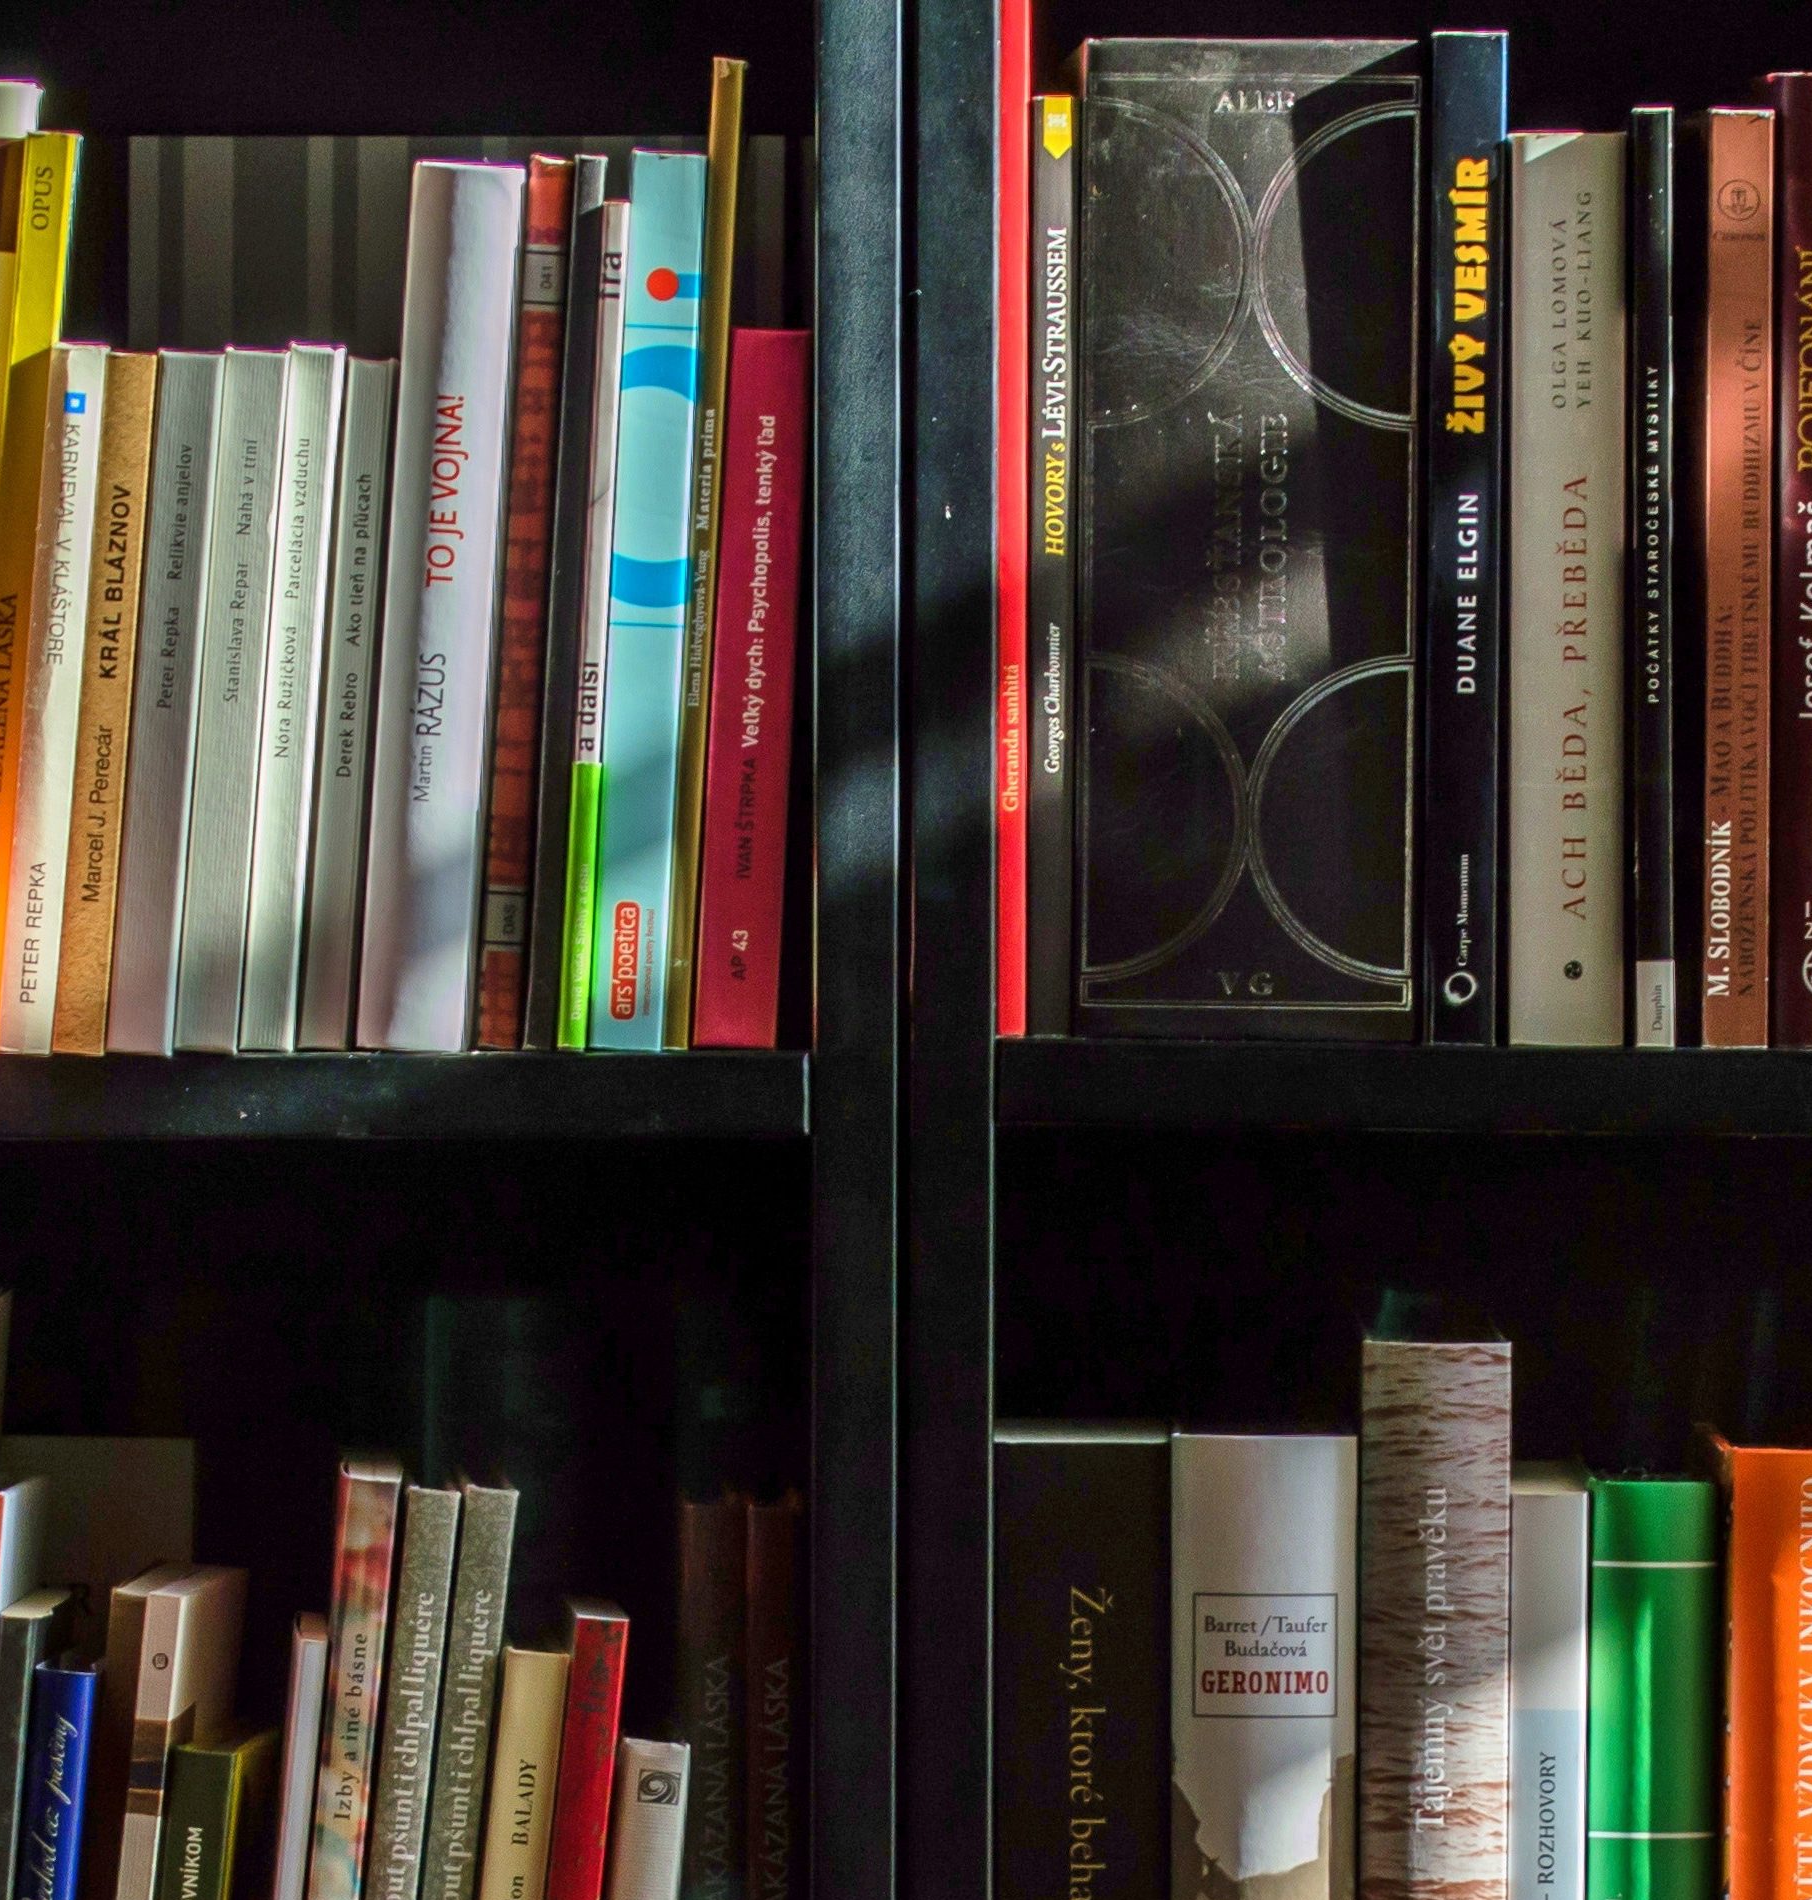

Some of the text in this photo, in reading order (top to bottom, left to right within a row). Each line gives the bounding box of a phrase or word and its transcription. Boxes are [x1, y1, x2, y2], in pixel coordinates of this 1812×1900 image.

[31, 166, 56, 231] OPUS
[1038, 227, 1069, 556] HOVORY s LÉVI-STRAUSSEM
[1446, 158, 1490, 694] DUANE ELGIN ŽIVÝ VESMÍR
[103, 484, 131, 603] BLÁZNOV
[426, 393, 468, 587] TO JE VOJNA!
[335, 672, 361, 778] Derek Rebro
[1003, 665, 1020, 812] Gheranda sanhitá
[1200, 1672, 1330, 1696] GERONIMO
